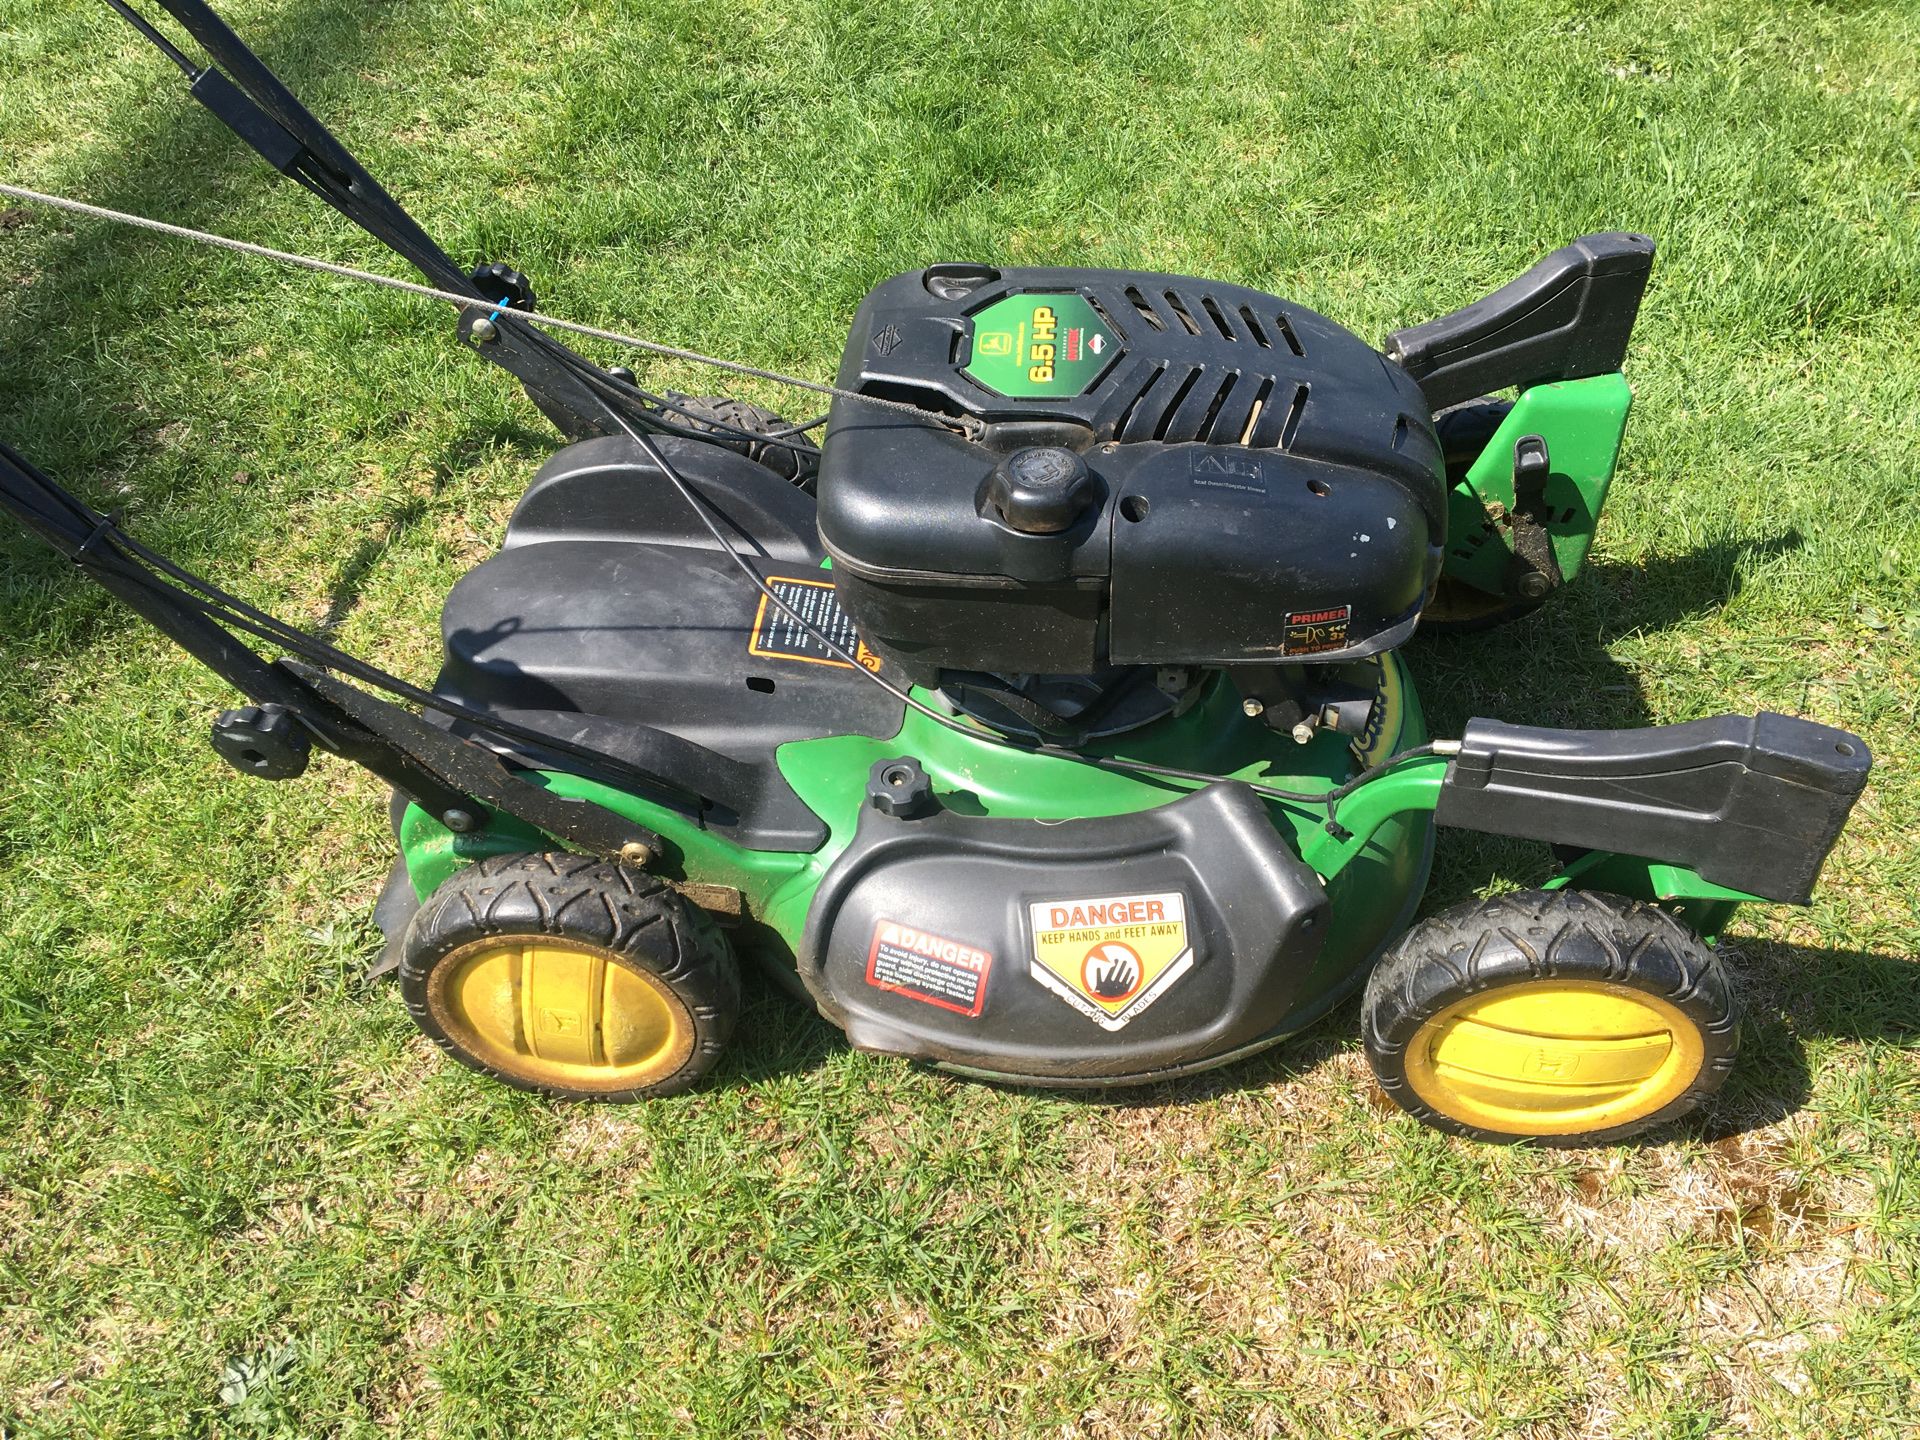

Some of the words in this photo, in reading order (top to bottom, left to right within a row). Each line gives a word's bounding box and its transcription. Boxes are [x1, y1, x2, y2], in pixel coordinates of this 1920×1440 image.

[1032, 307, 1057, 340] HP
[1067, 327, 1079, 361] INTEK
[1029, 344, 1055, 383] 6.5
[1291, 608, 1348, 625] PRIMER
[1050, 900, 1165, 929] DANGER
[901, 929, 985, 970] DANGER
[1041, 932, 1065, 945] KEEP
[1069, 930, 1101, 942] HANDS
[1104, 929, 1121, 940] and
[1124, 926, 1147, 938] FEET
[1150, 924, 1179, 936] AWAY
[878, 952, 900, 963] mower
[900, 958, 926, 971] without
[924, 966, 957, 982] protective
[956, 977, 978, 988] mulch
[880, 943, 890, 952] To
[890, 947, 909, 958] avoid
[908, 953, 931, 966] injury,
[930, 960, 941, 969] do
[940, 963, 953, 972] not
[952, 967, 979, 981] operate
[898, 965, 913, 974] side
[913, 970, 947, 986] discharge
[946, 980, 968, 992] chute,
[875, 965, 895, 977] grass
[894, 971, 923, 985] bagging
[922, 980, 946, 993] system
[946, 987, 975, 1002] fastened
[1121, 991, 1157, 1023] BLADES
